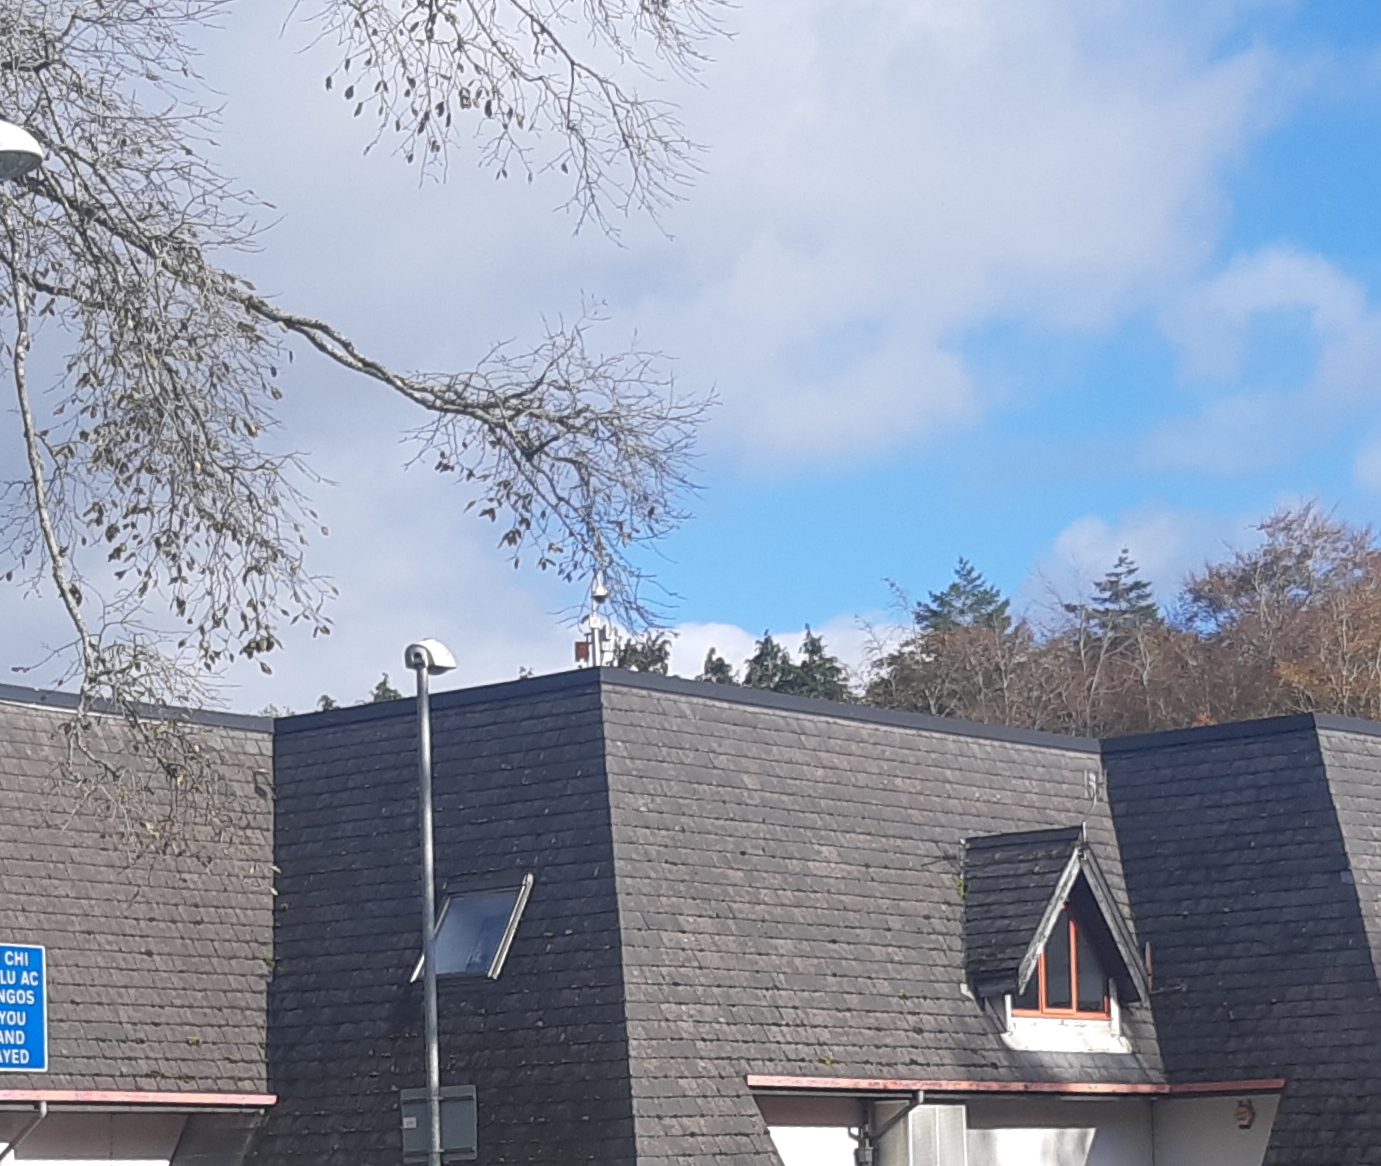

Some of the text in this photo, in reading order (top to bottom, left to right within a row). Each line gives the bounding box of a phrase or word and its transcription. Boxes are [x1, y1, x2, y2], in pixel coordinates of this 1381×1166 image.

[5, 952, 28, 966] CHI
[21, 972, 38, 985] AC
[0, 1012, 26, 1025] YOU
